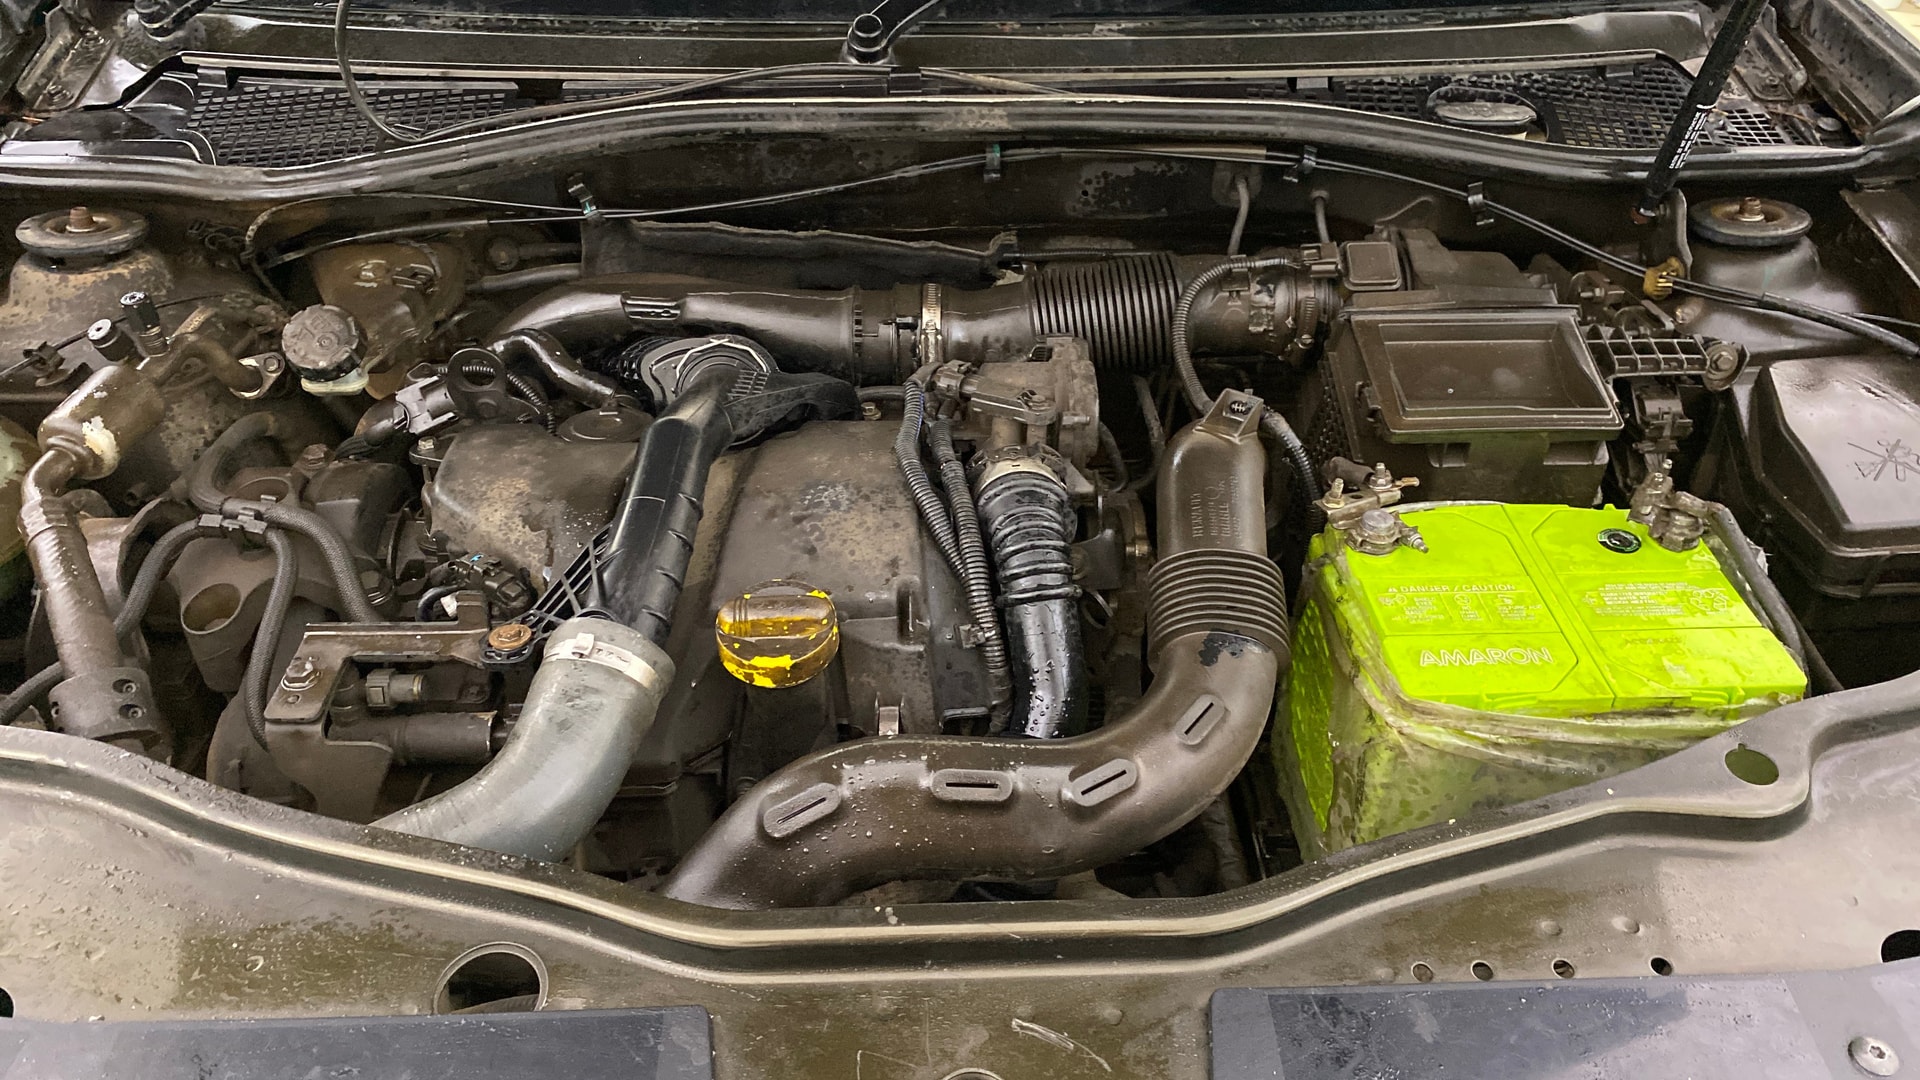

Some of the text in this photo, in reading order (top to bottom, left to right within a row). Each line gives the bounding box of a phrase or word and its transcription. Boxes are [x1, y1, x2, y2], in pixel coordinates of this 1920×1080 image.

[1400, 584, 1450, 593] DANGER
[1462, 583, 1517, 592] CAUTION
[1420, 647, 1553, 666] AMARON
